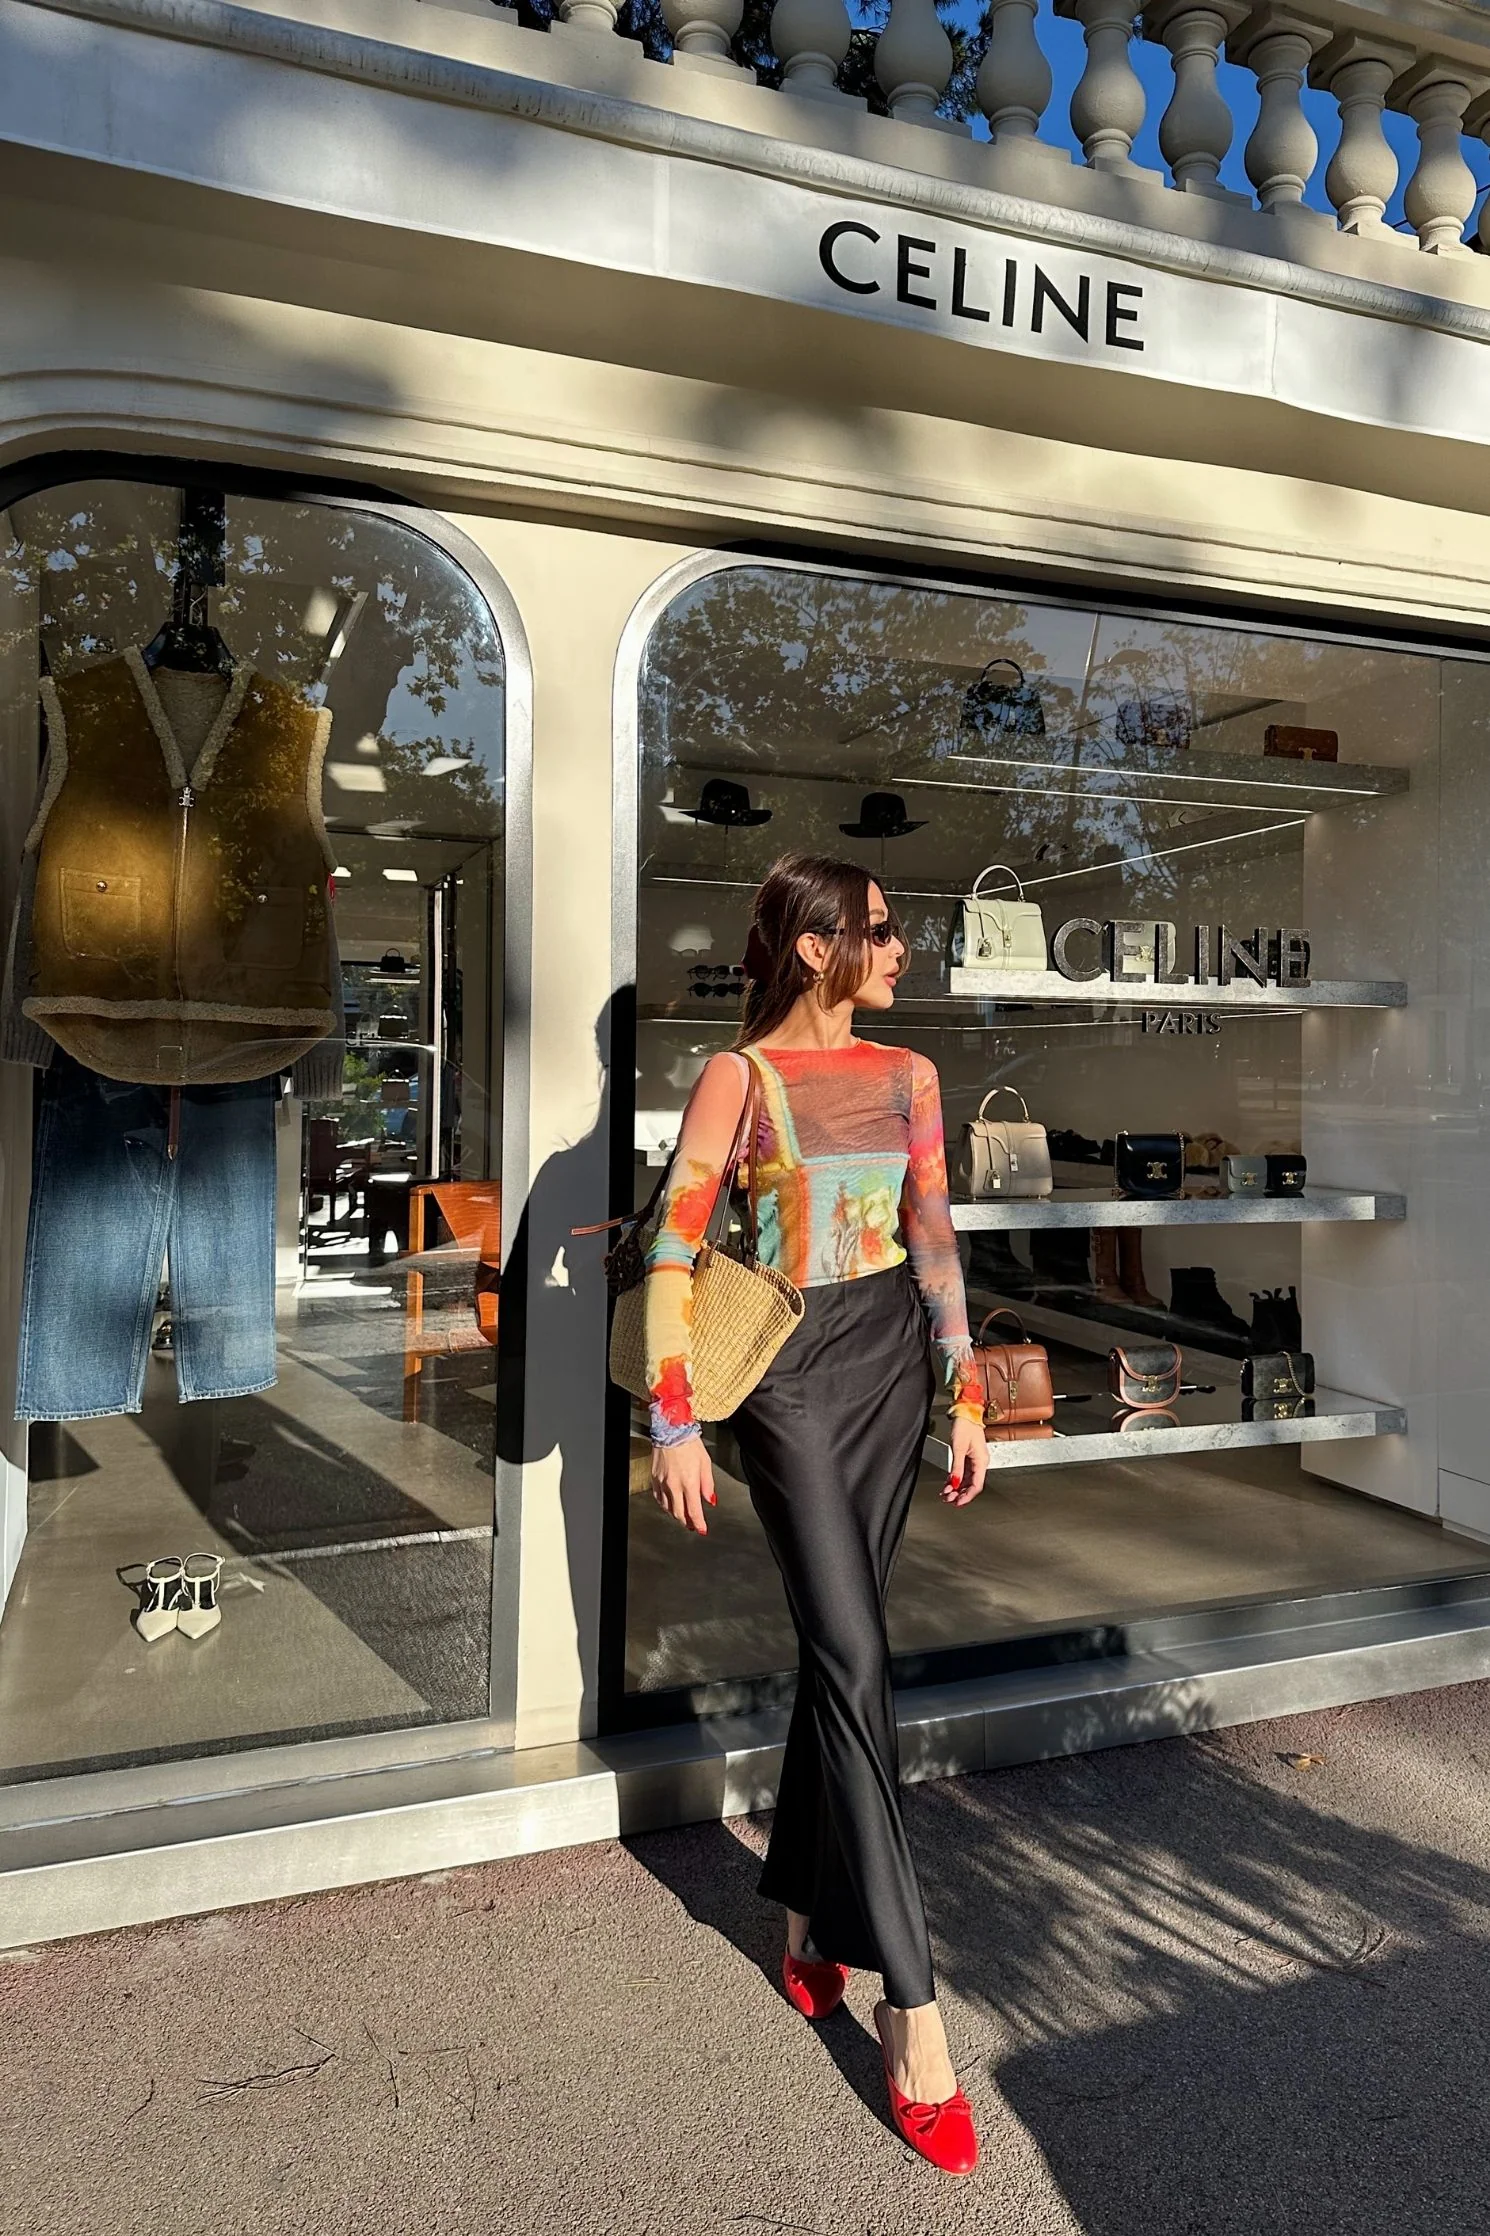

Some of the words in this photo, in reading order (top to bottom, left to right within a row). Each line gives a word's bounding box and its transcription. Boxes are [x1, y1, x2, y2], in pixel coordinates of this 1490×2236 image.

[818, 220, 1145, 352] CELINE
[1053, 917, 1312, 988] CELINE
[1141, 1010, 1222, 1035] PARIS
